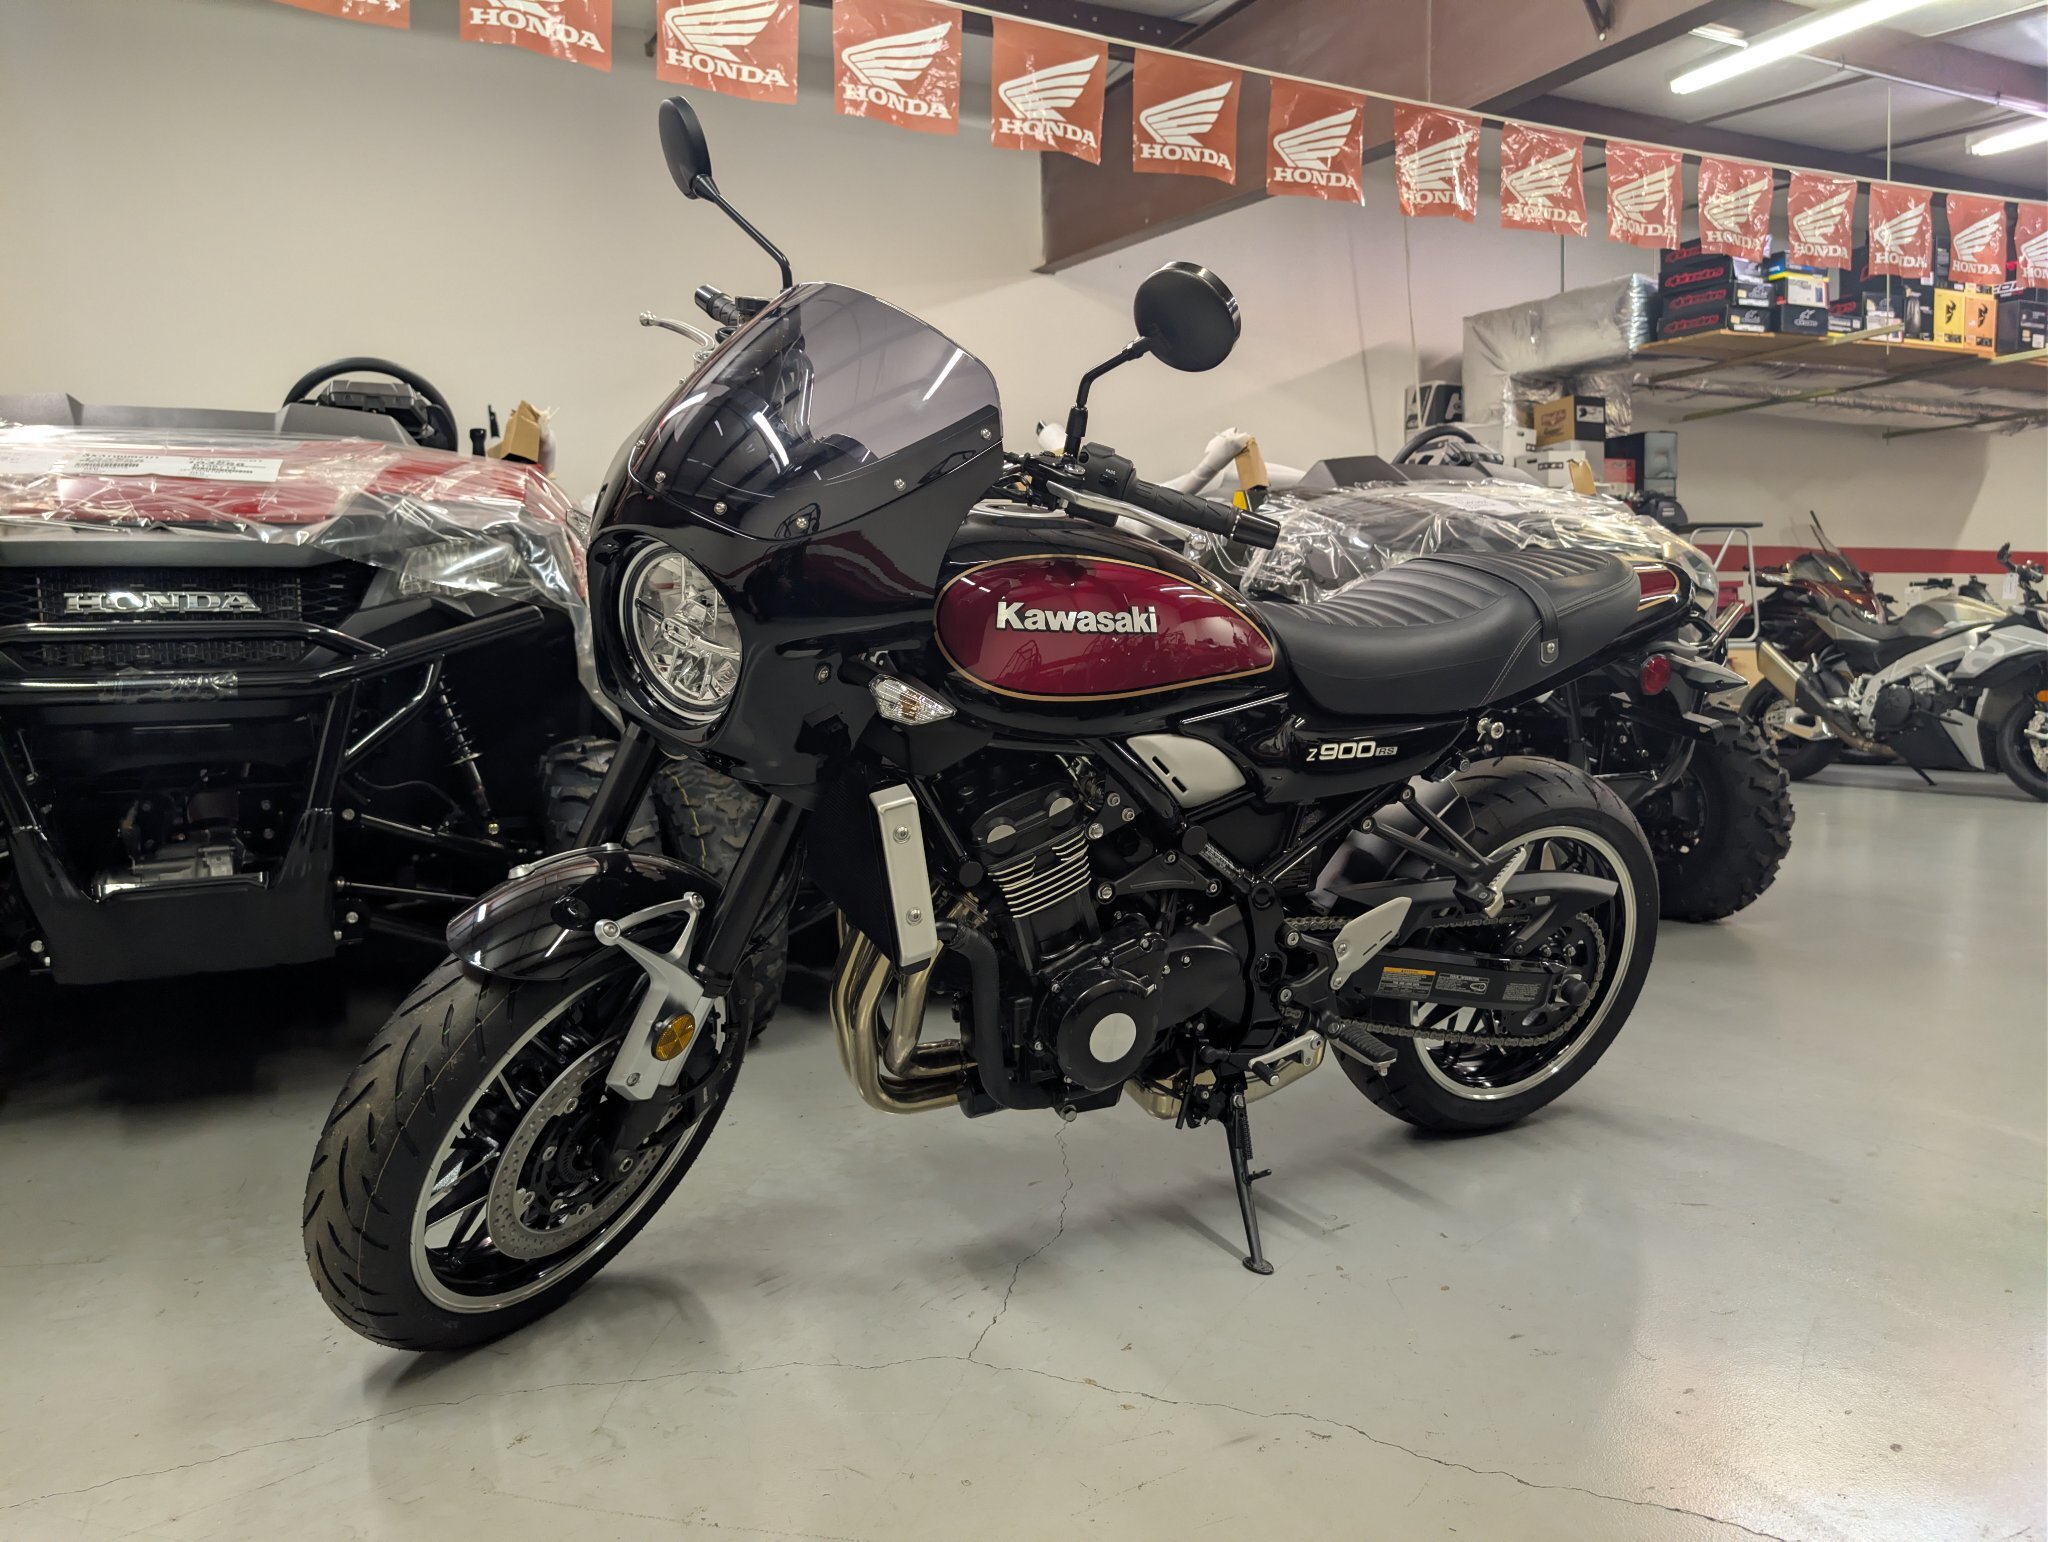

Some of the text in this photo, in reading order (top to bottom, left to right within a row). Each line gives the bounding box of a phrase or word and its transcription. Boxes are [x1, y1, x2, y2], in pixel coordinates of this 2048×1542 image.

[469, 8, 605, 52] HONDA
[665, 47, 789, 87] HONDA
[842, 84, 952, 119] HONDA
[999, 117, 1098, 148] HONDA
[1140, 143, 1232, 170] HONDA
[1274, 167, 1359, 191] HONDA
[1507, 203, 1582, 223] HONDA
[1615, 218, 1676, 237] HONDA
[1706, 231, 1761, 250] HONDA
[1793, 242, 1848, 259] HONDA
[1952, 260, 2001, 275] HONDA
[64, 592, 262, 614] HONDA
[996, 601, 1158, 633] Kawasaki
